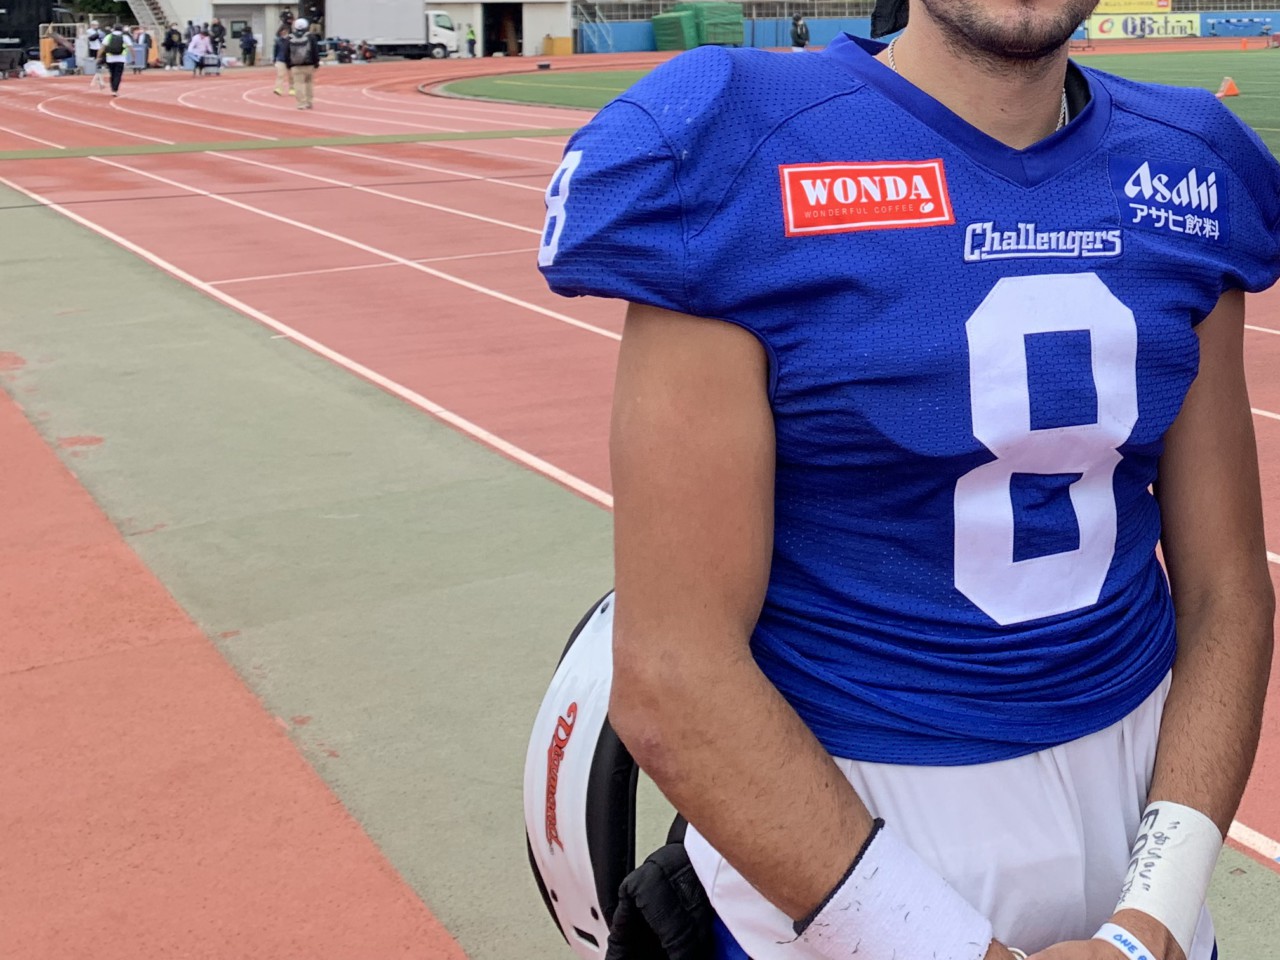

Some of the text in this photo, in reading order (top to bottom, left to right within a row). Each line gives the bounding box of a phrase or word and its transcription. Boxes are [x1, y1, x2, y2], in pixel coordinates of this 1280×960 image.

[1122, 16, 1155, 36] QB
[800, 175, 932, 206] WONDA
[1124, 161, 1219, 213] Asahi
[537, 150, 583, 267] 8
[804, 203, 914, 219] WONDERFUL COFFEE
[1129, 203, 1220, 240] アサヒ飲料
[964, 222, 1121, 261] Challengers
[954, 272, 1139, 626] 8
[1113, 933, 1138, 954] ONE
